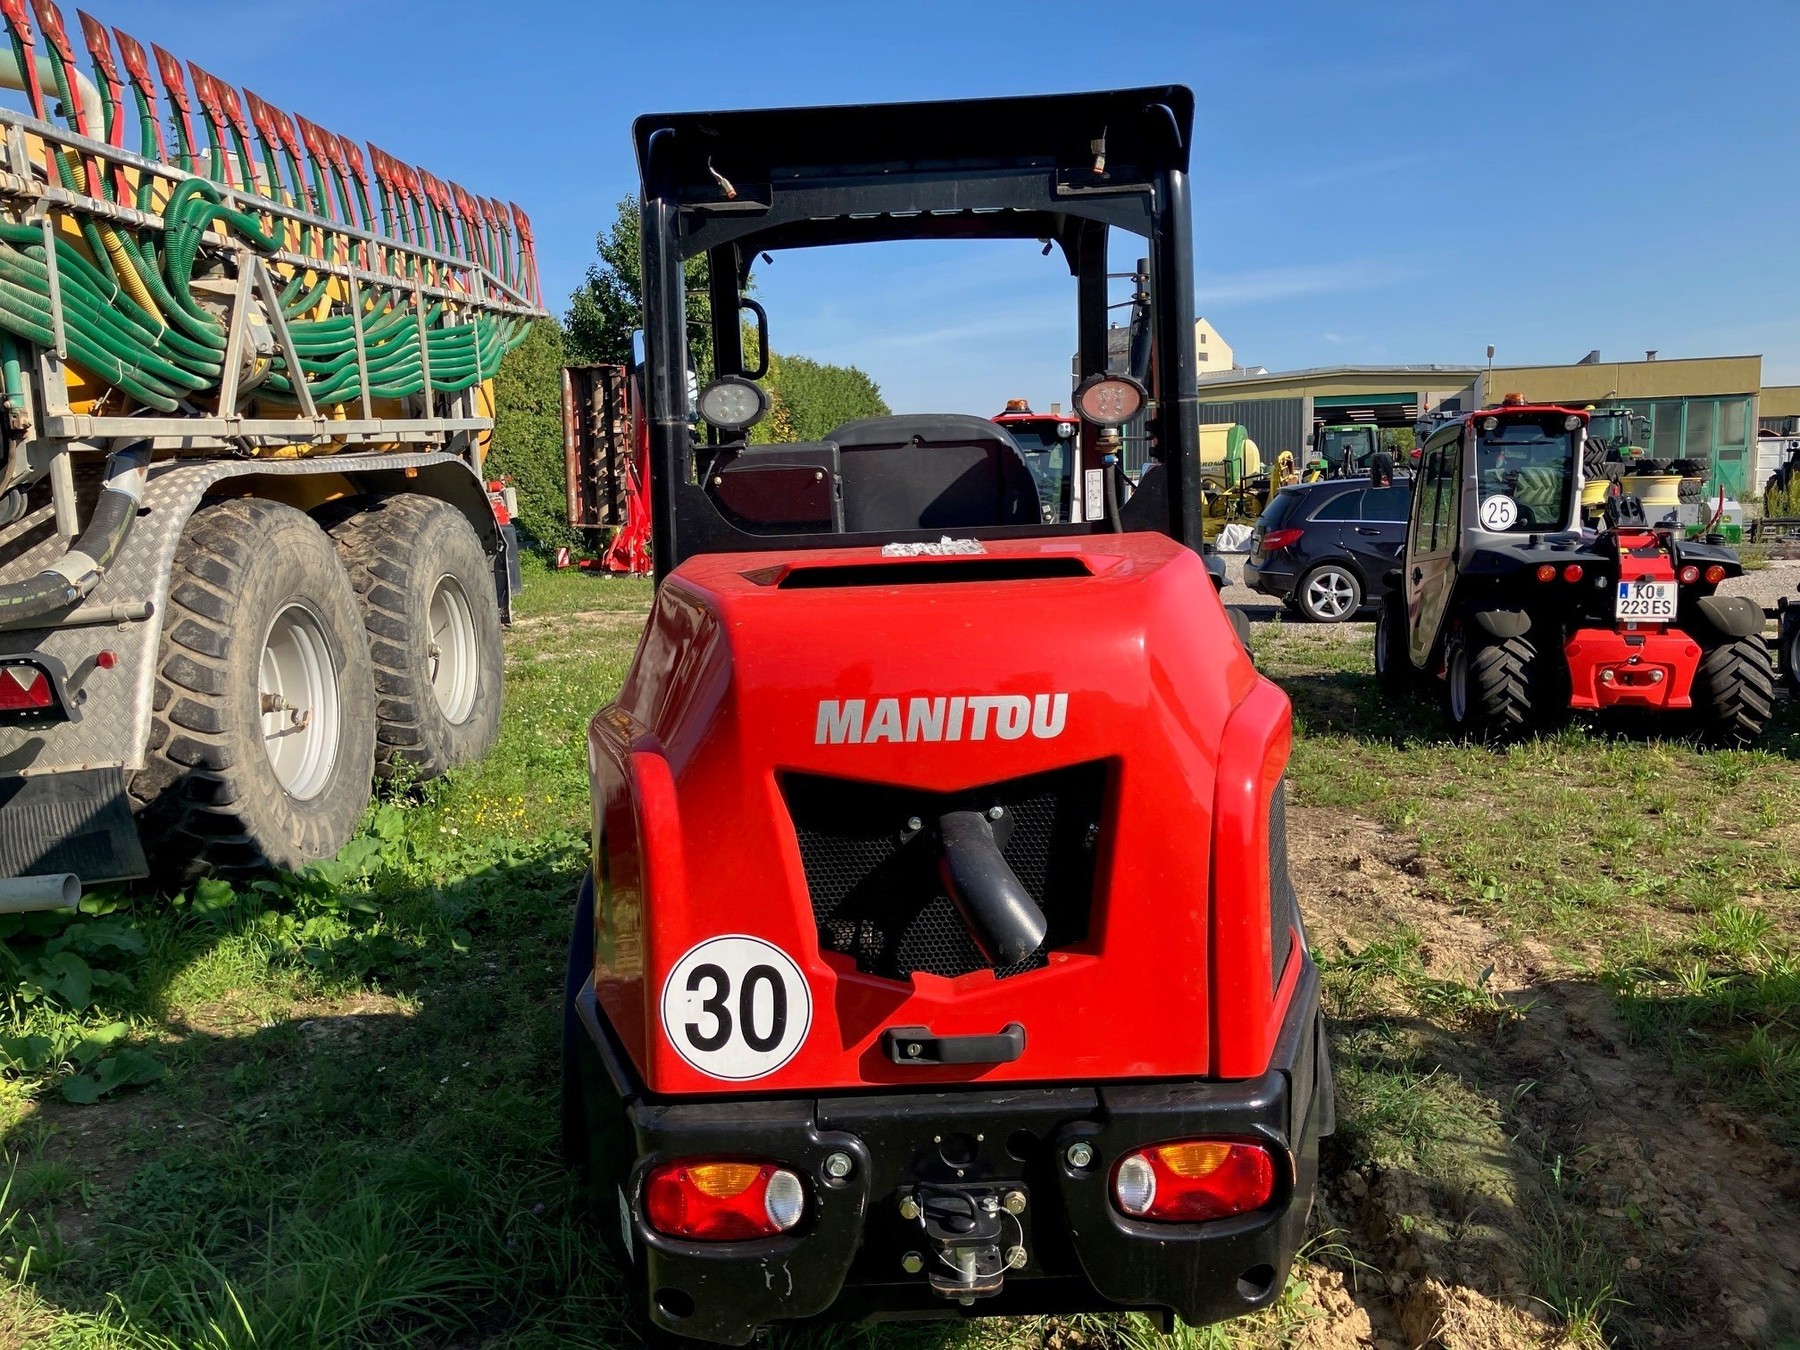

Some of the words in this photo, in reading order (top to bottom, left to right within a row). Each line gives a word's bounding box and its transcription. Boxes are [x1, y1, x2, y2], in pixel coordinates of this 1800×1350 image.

[1488, 501, 1510, 523] 25
[1636, 585, 1655, 599] KO
[1621, 600, 1649, 614] 223
[1652, 600, 1671, 614] ES
[815, 693, 1069, 745] MANITOU
[685, 963, 788, 1053] 30
